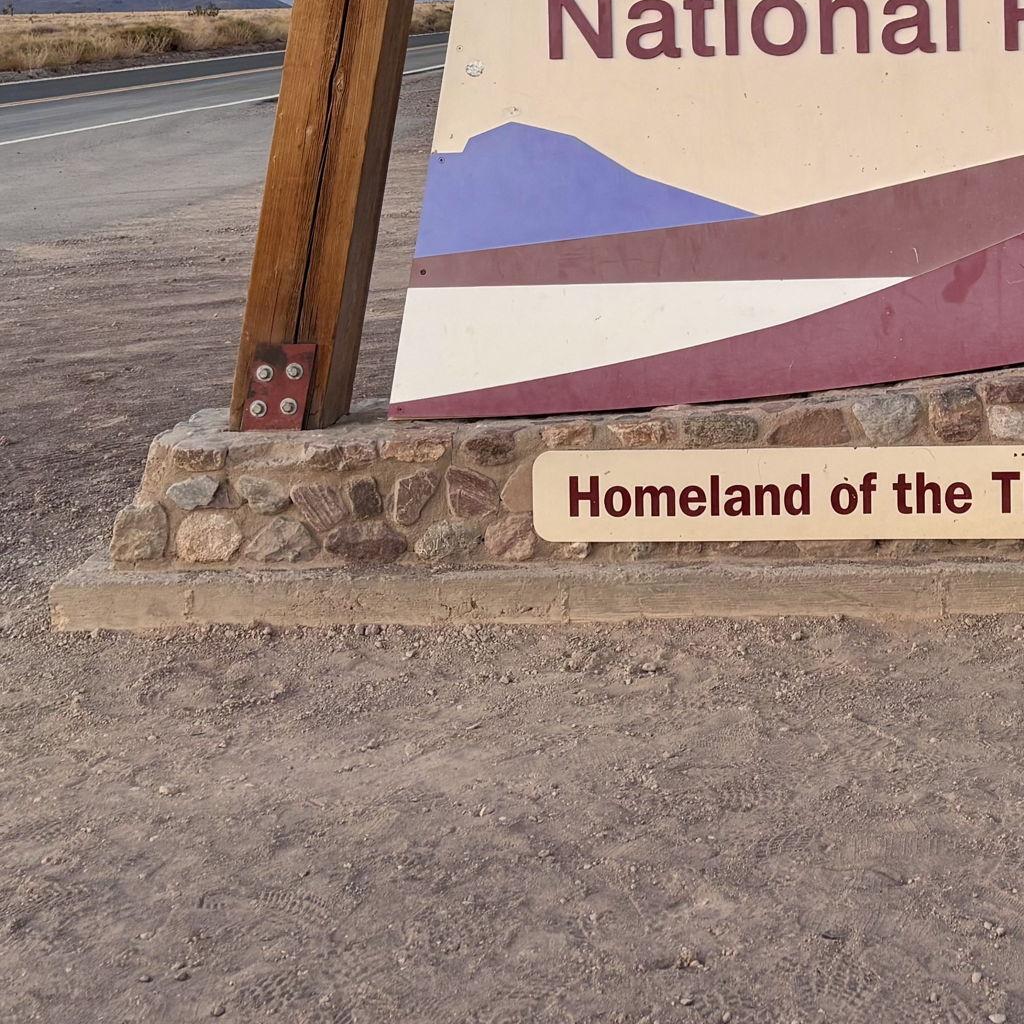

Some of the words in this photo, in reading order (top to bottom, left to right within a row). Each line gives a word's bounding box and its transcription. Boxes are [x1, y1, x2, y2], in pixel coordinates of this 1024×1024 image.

[568, 473, 811, 518] Homeland
[830, 471, 878, 516] of
[893, 471, 973, 515] the
